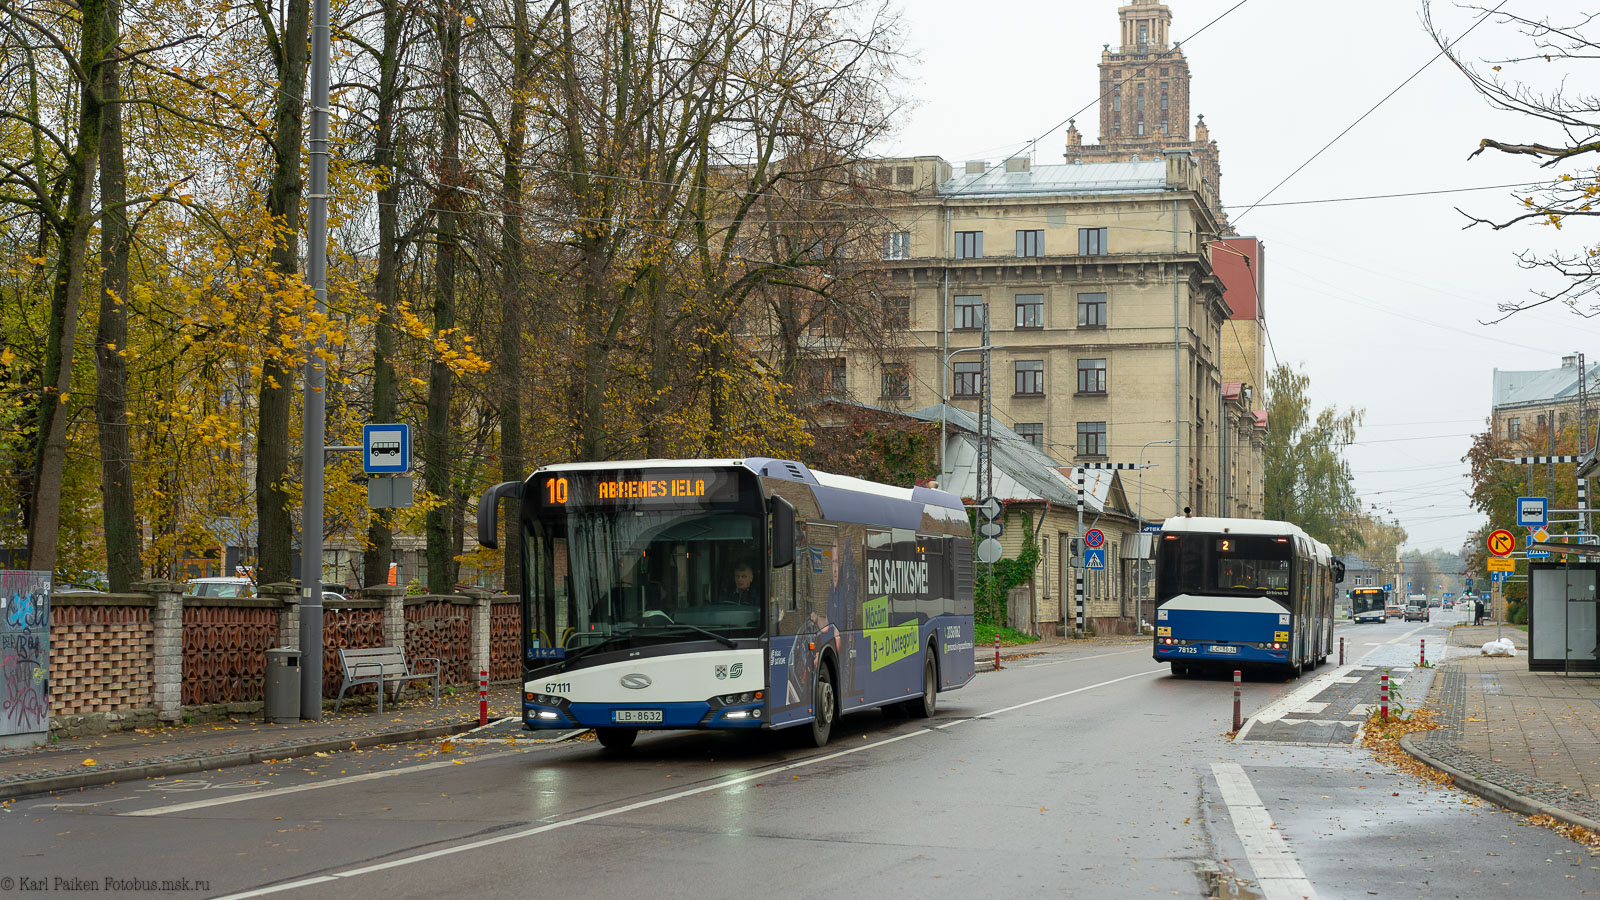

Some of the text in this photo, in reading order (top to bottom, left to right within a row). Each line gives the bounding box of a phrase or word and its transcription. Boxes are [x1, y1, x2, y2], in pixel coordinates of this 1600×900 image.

[546, 477, 568, 504] 10
[671, 479, 705, 496] IELA
[1222, 540, 1229, 551] 2
[868, 559, 882, 594] ESI
[873, 640, 878, 662] B
[885, 635, 890, 657] D
[1178, 646, 1197, 654] 78125
[545, 682, 571, 693] 67111
